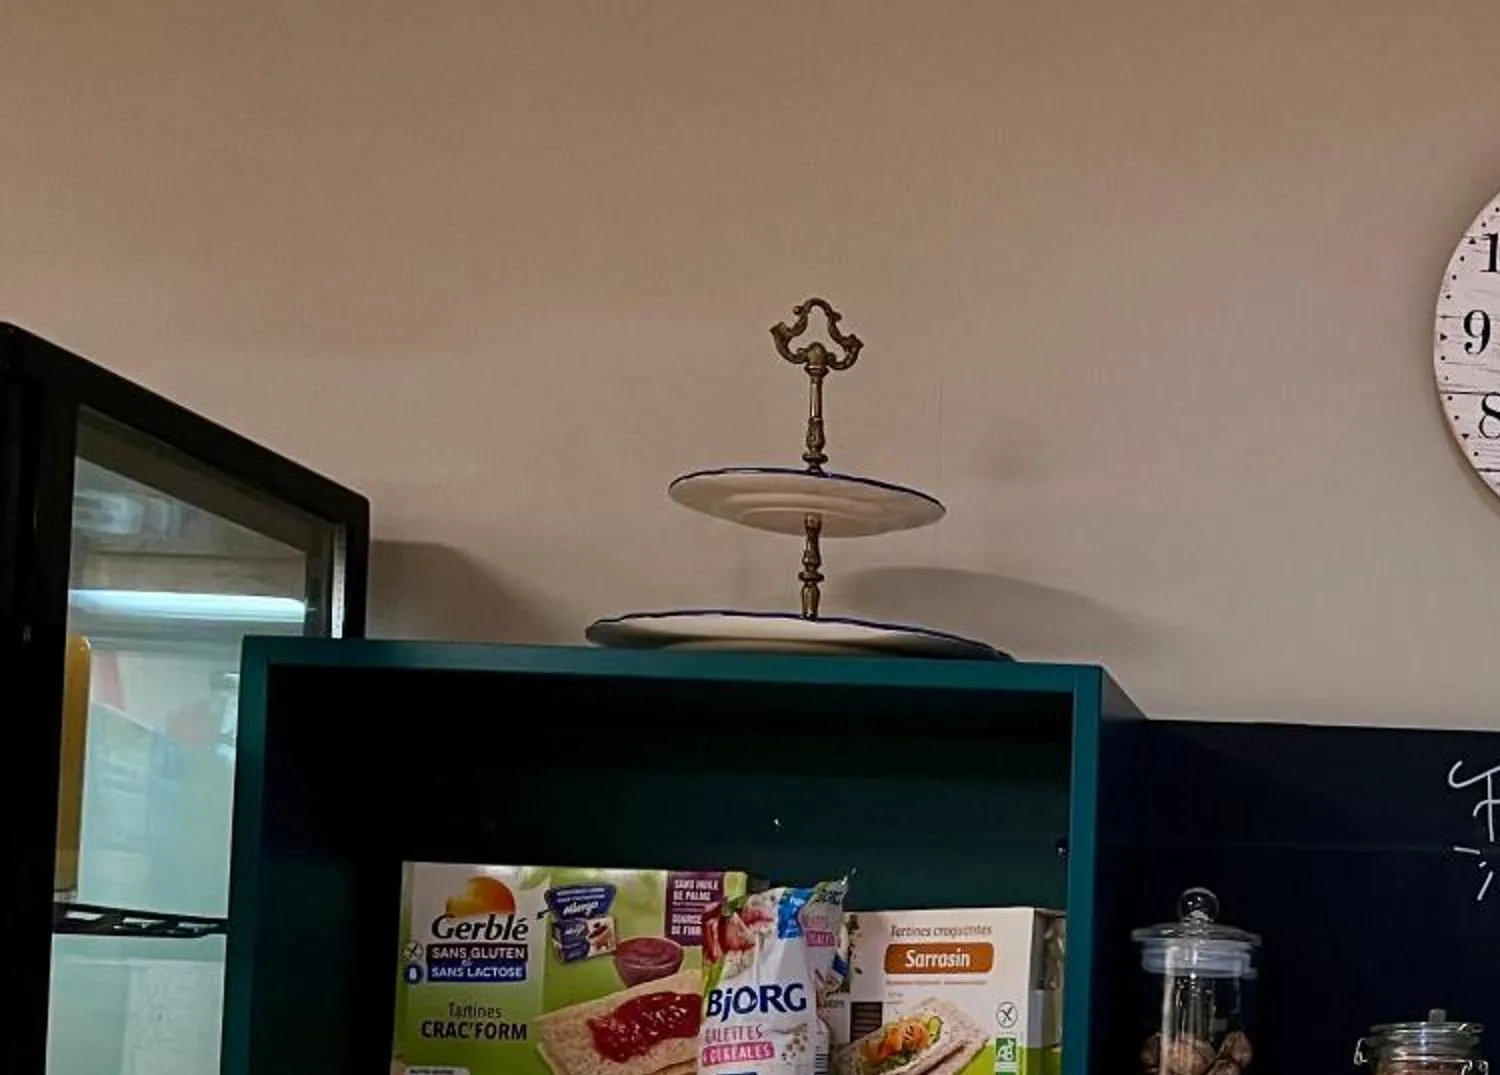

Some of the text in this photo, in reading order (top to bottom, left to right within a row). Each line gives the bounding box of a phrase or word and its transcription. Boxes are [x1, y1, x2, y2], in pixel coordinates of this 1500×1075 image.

[1462, 309, 1491, 354] 9
[431, 913, 529, 941] Gerblé
[431, 947, 525, 960] SANS GLUTEN
[904, 947, 971, 969] Sarrasin
[431, 967, 523, 978] SANS LACTOSE
[448, 1002, 503, 1019] Tartines
[421, 1021, 528, 1041] CRAC'FORM
